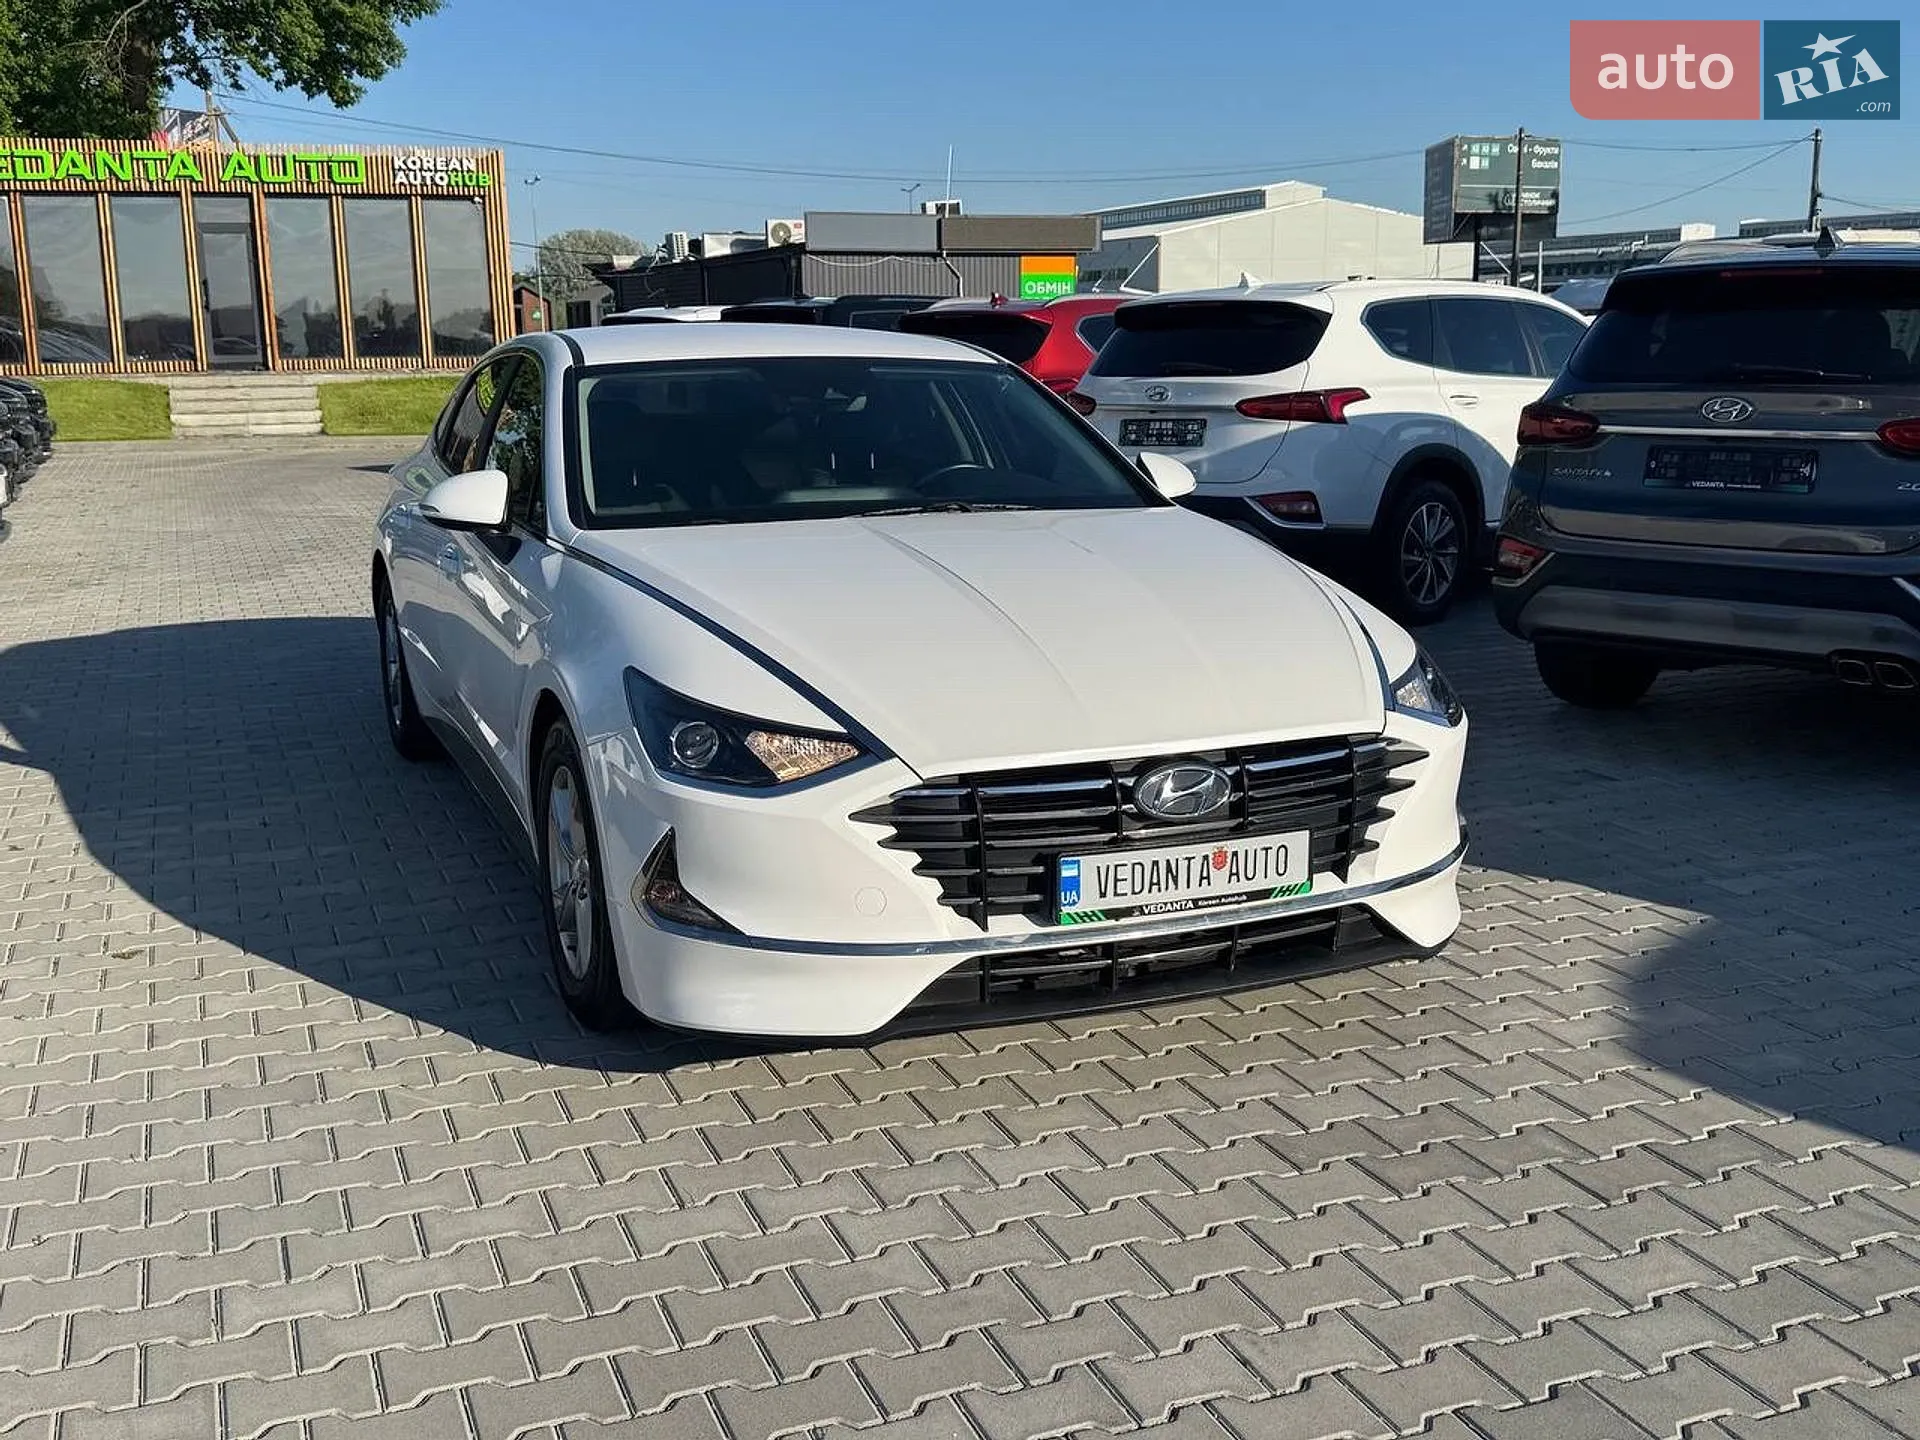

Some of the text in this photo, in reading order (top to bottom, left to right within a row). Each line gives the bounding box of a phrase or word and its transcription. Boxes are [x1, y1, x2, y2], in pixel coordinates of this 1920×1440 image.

[222, 151, 365, 184] AUTO
[393, 157, 476, 170] KOREAN
[394, 170, 490, 187] AUTOHUB
[1024, 281, 1071, 296] ОБМІН
[1096, 843, 1289, 899] VEDANTA AUTO
[1060, 891, 1079, 904] UA
[1142, 901, 1194, 915] VEDANTA
